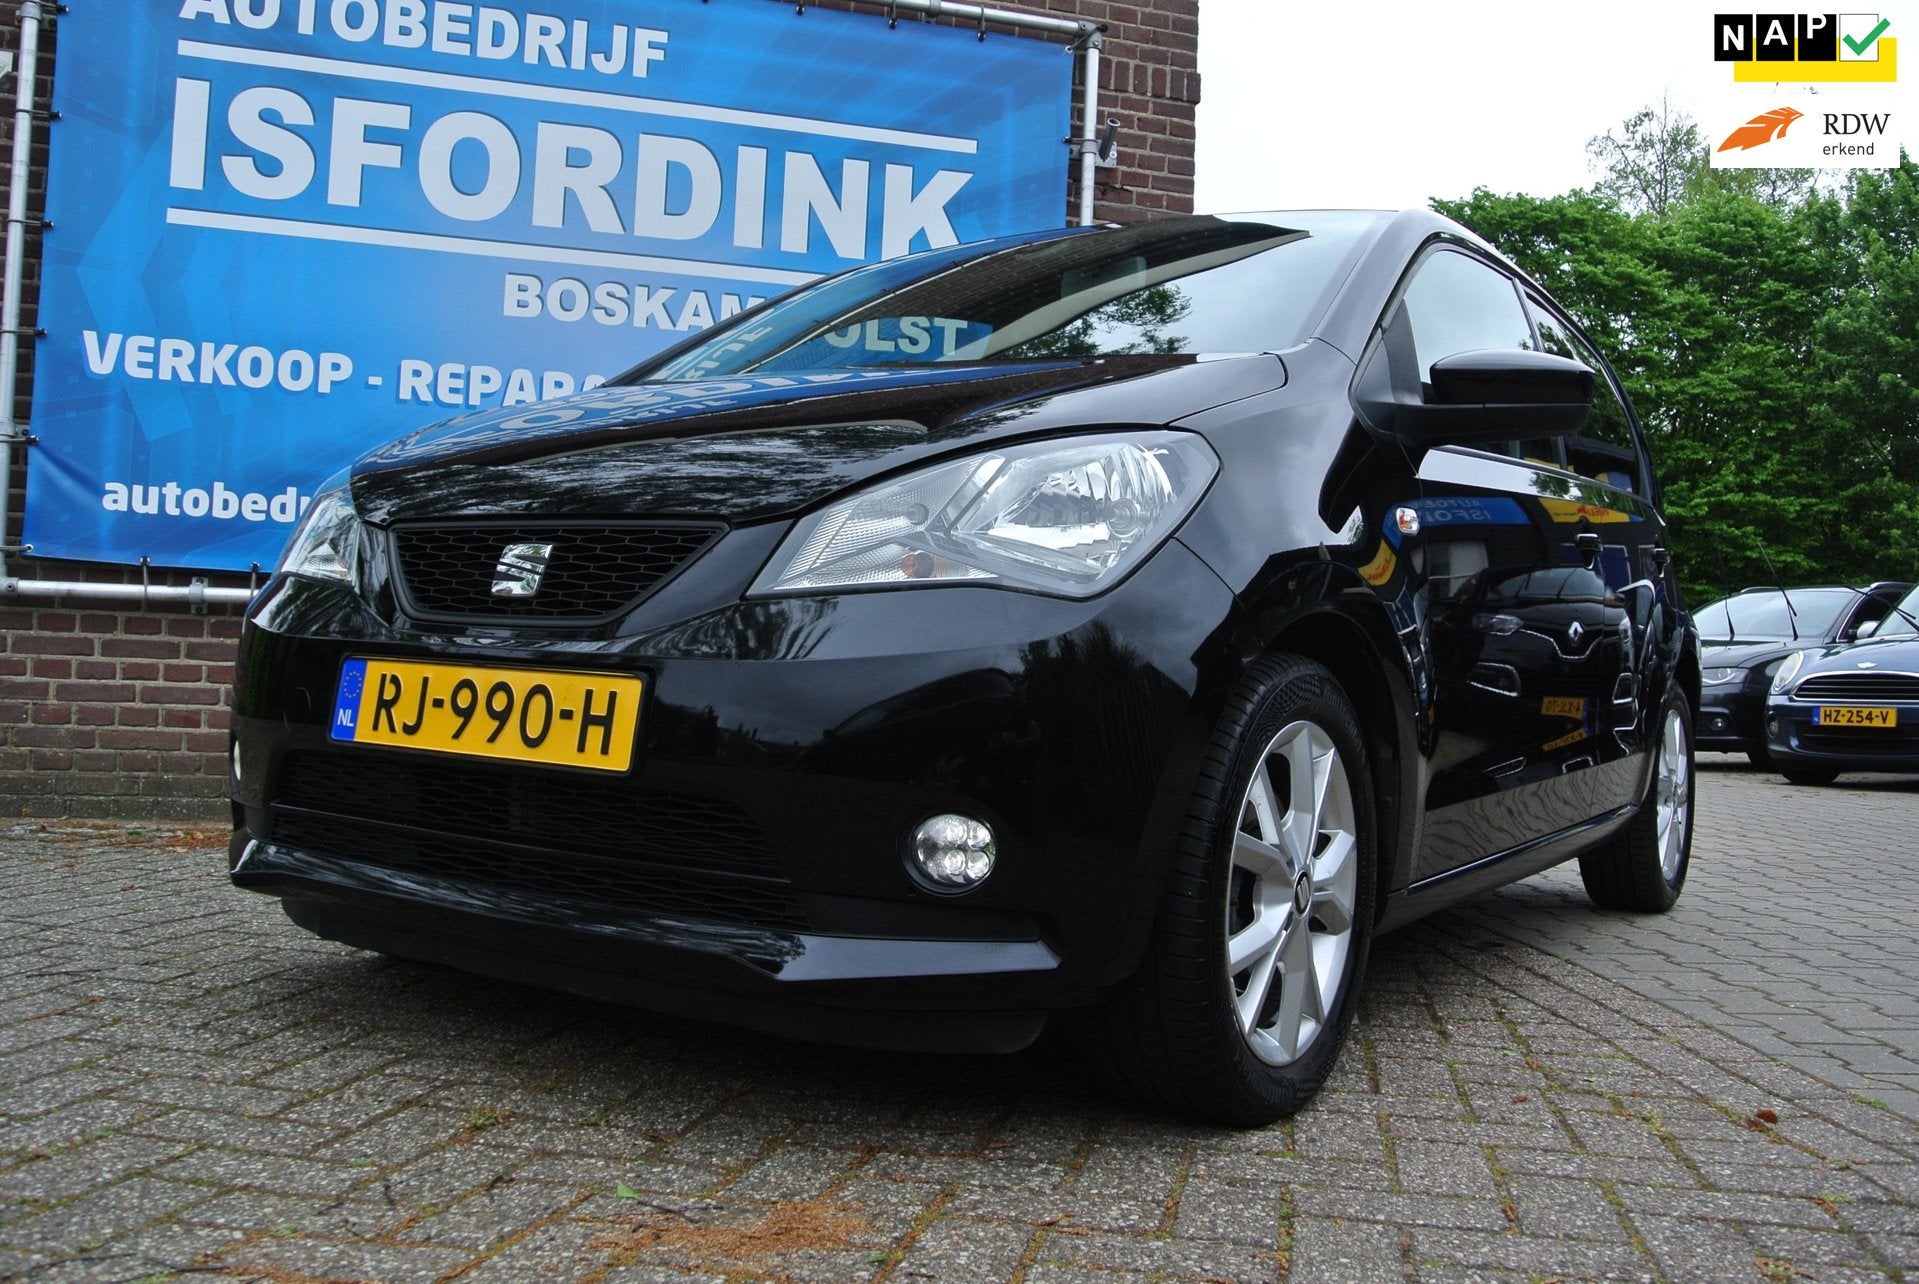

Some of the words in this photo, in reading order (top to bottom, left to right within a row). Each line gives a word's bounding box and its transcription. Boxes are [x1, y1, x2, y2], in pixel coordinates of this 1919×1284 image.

[169, 77, 974, 261] ISFORDINK
[82, 330, 354, 394] VERKOOP
[337, 708, 355, 728] NL
[372, 671, 619, 756] RJ-990-H
[1823, 709, 1890, 725] HZ-254-V
